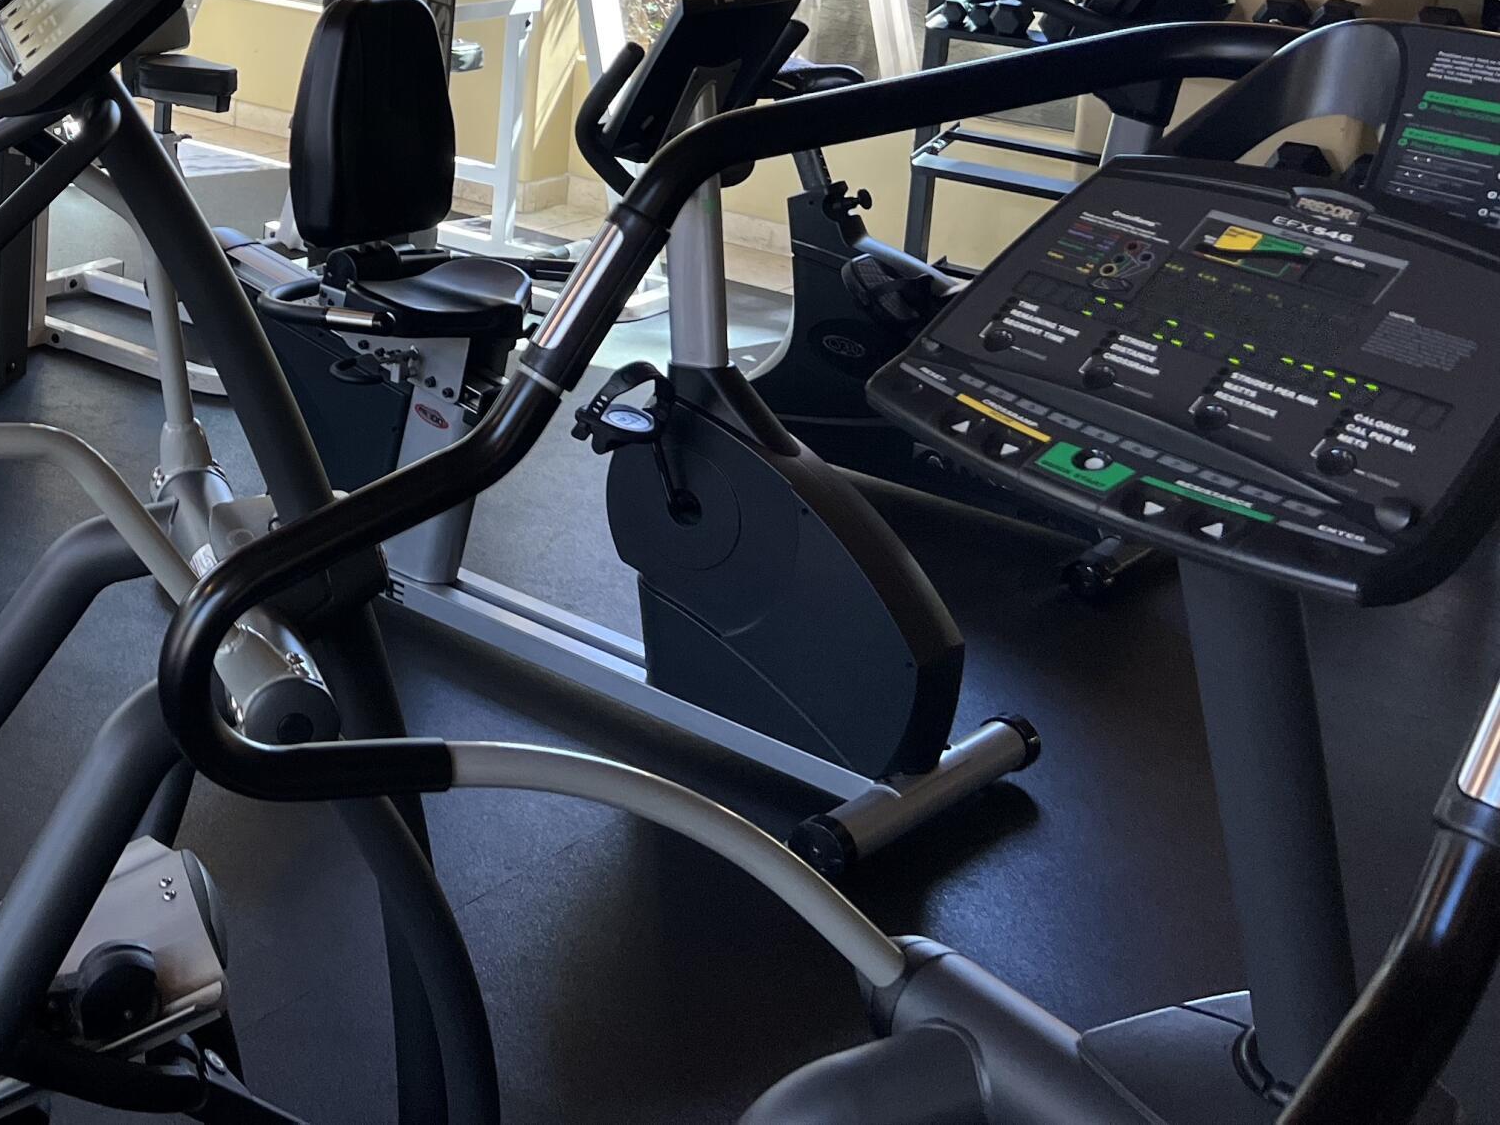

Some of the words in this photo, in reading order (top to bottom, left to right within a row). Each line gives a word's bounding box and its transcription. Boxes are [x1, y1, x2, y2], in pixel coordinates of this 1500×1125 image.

[1297, 197, 1355, 221] PRECOR
[1272, 215, 1355, 243] EFX546
[1018, 300, 1040, 312] TIME
[1043, 331, 1066, 344] TIME
[1058, 324, 1080, 337] TIME
[1222, 381, 1258, 398] WATTS
[1230, 372, 1275, 393] STRIDES
[1274, 386, 1297, 400] PER
[1296, 394, 1319, 407] MIN
[1214, 390, 1278, 418] RESISTANCE
[1353, 413, 1409, 437] CALORIES
[1337, 433, 1369, 450] METS
[1345, 423, 1367, 437] CAL
[1368, 430, 1393, 444] PER
[1392, 439, 1417, 453] MIN
[1318, 525, 1366, 542] ENTER
